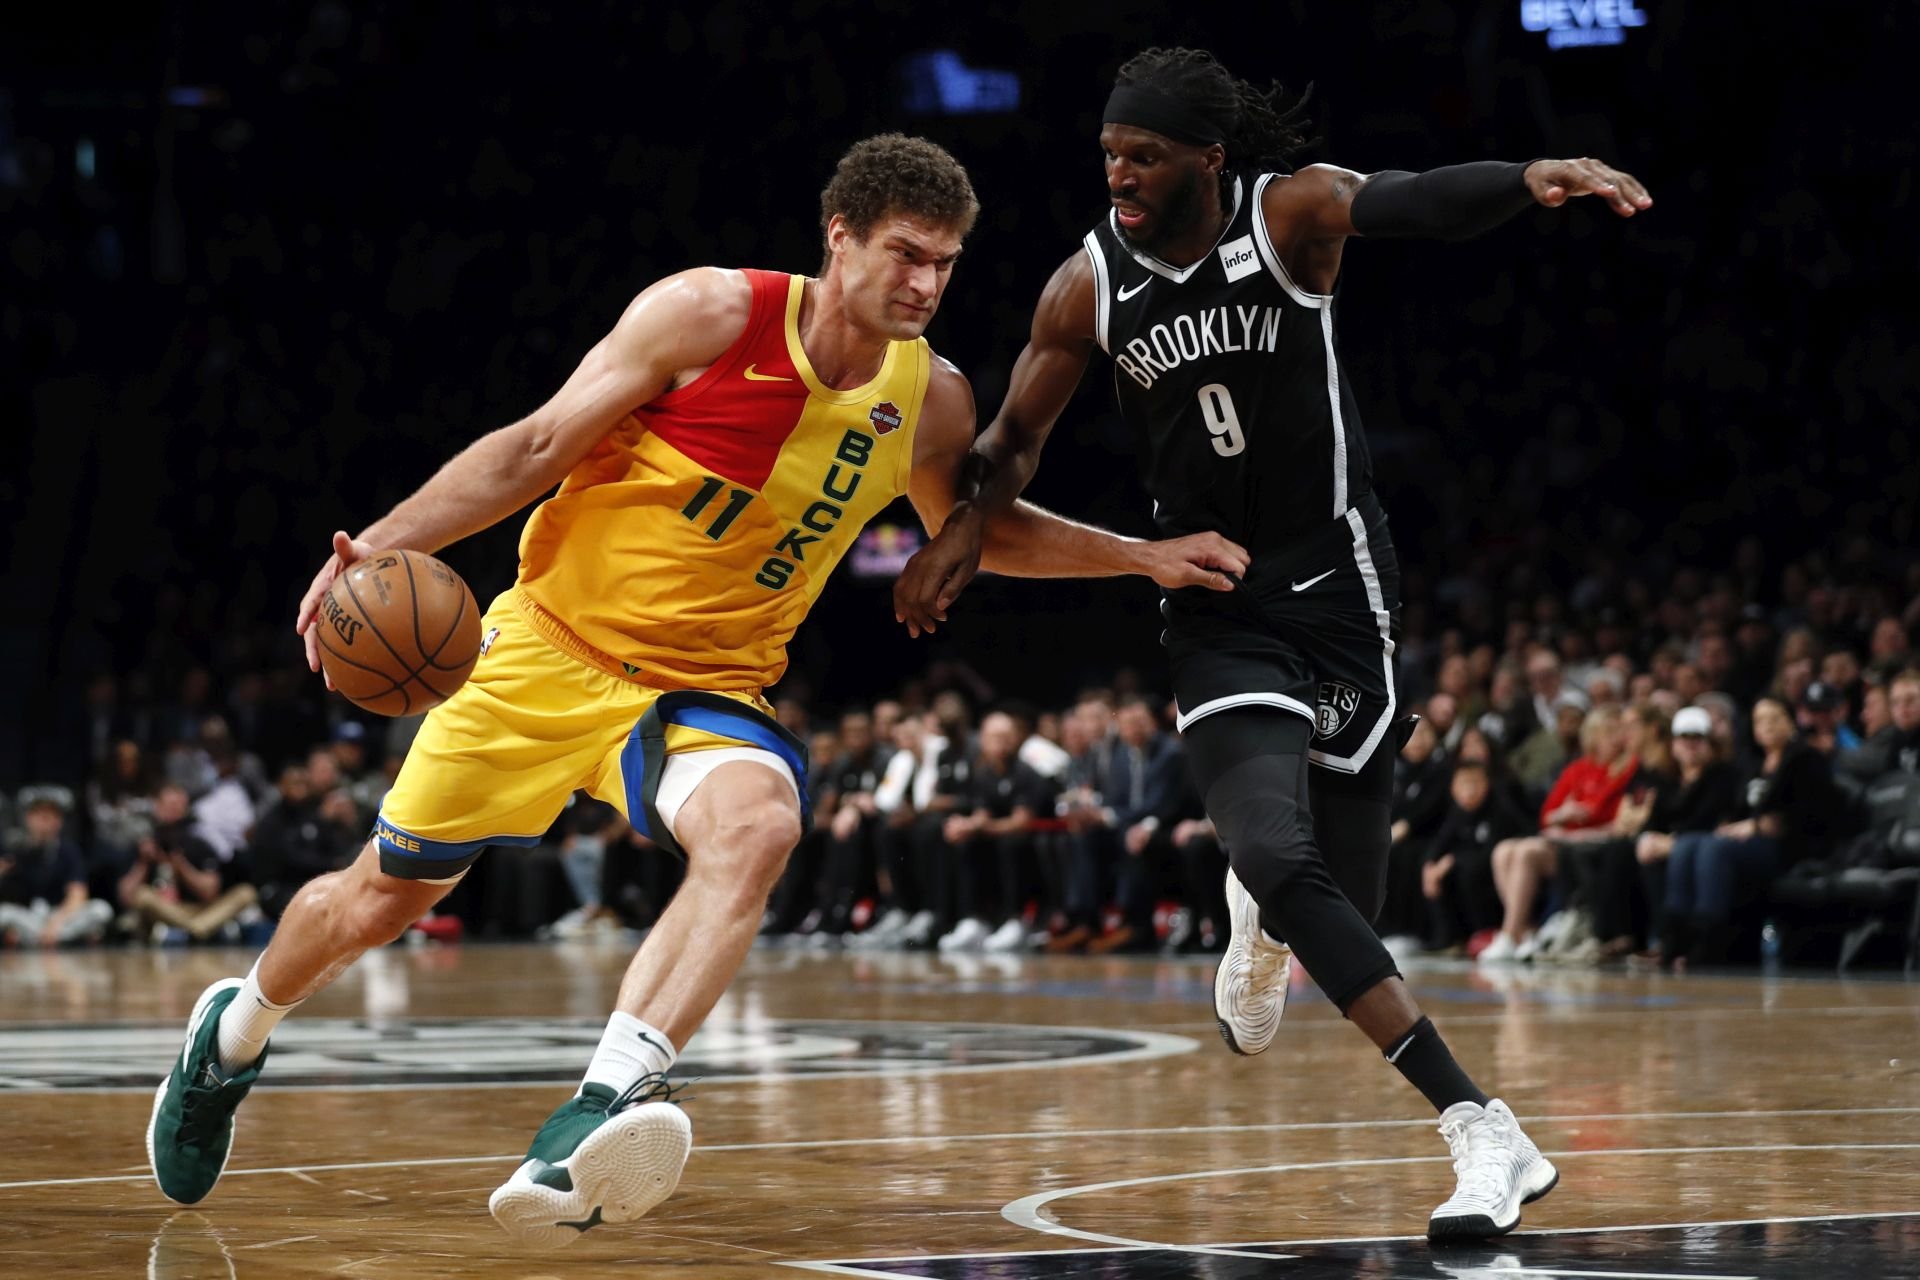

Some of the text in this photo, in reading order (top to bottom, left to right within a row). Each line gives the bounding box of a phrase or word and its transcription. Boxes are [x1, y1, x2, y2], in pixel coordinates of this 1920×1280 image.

[1521, 0, 1646, 31] BEVEL
[1224, 249, 1254, 269] infor
[1116, 305, 1282, 390] BROOKLYN
[1197, 383, 1246, 457] 9
[681, 476, 755, 541] 11
[755, 428, 874, 590] BUCKS
[378, 822, 420, 853] UKEE
